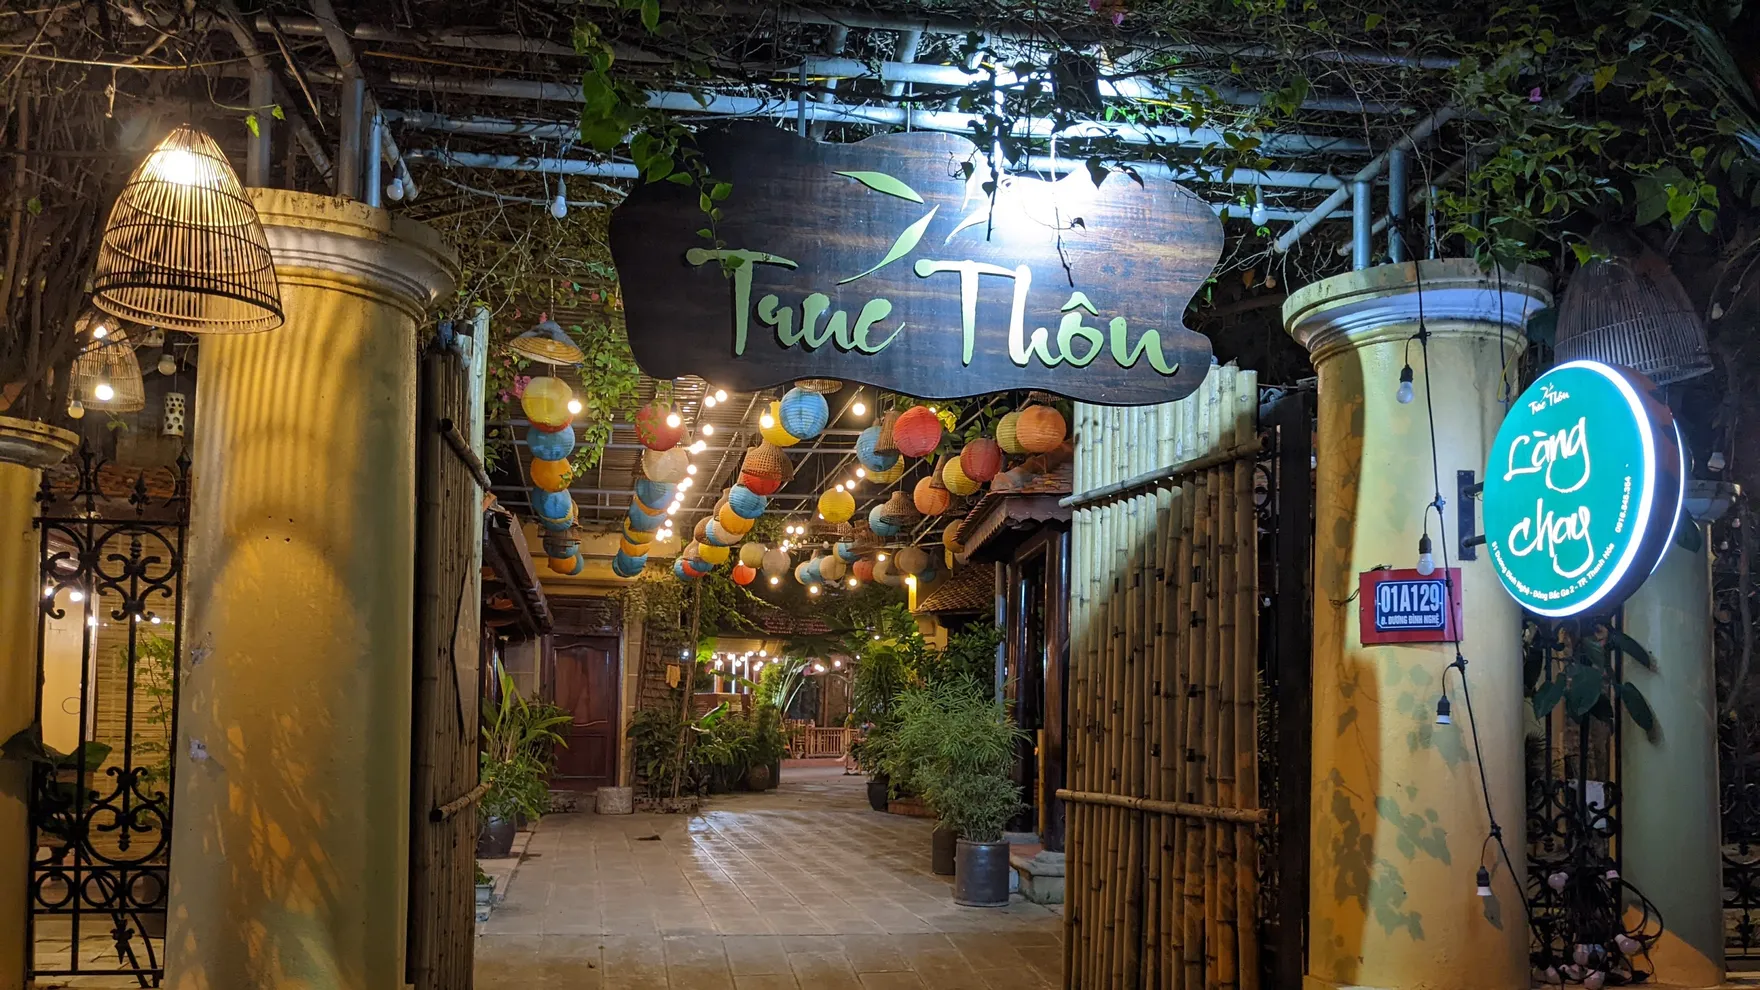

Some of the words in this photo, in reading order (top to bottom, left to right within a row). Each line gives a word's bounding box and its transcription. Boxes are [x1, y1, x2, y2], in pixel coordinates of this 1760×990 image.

[914, 258, 1179, 377] Thôn
[1503, 416, 1591, 494] Làng
[1508, 497, 1594, 579] chay
[1381, 583, 1440, 613] 01A129
[1560, 589, 1570, 598] Ga
[1569, 585, 1575, 594] 2
[1586, 558, 1605, 580] Thanh
